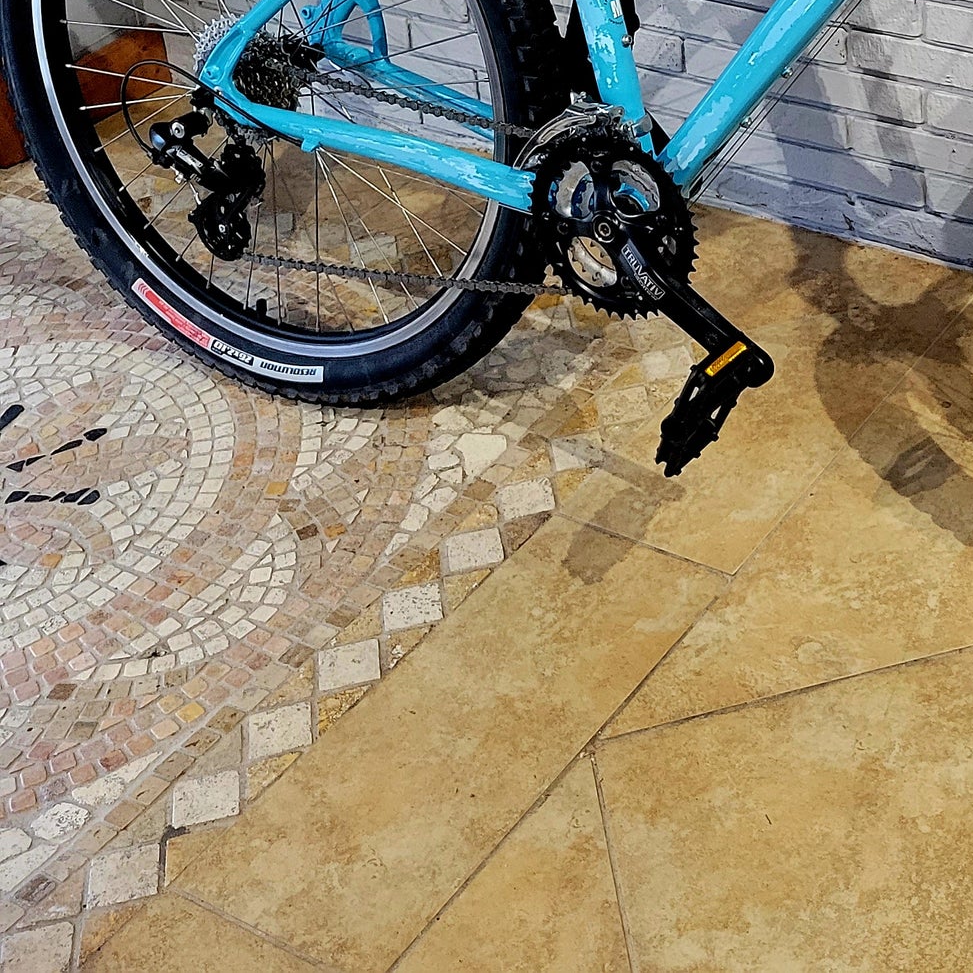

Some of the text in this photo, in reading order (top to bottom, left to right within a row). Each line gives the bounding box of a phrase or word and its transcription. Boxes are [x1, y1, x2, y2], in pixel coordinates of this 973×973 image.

[622, 245, 664, 297] TRUVATIV
[213, 339, 317, 376] RESOLUTION 26x2.10
